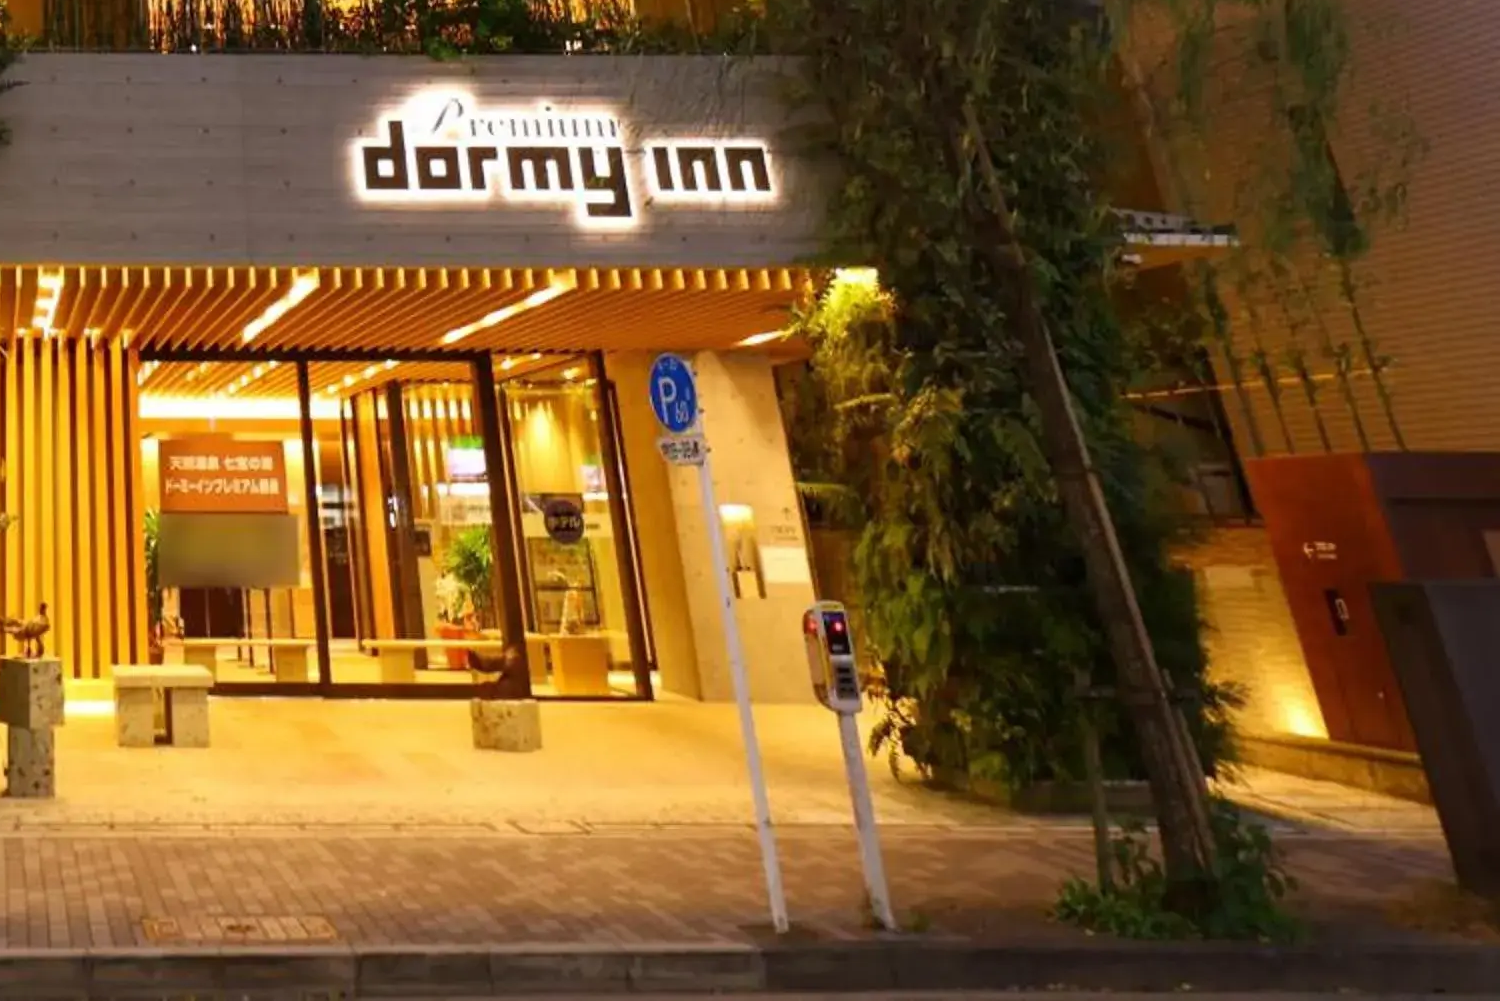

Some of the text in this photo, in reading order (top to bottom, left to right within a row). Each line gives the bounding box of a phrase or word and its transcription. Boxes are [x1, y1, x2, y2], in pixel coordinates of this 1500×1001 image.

[429, 97, 621, 139] Premium
[361, 119, 772, 217] dormy inn
[657, 377, 678, 424] P
